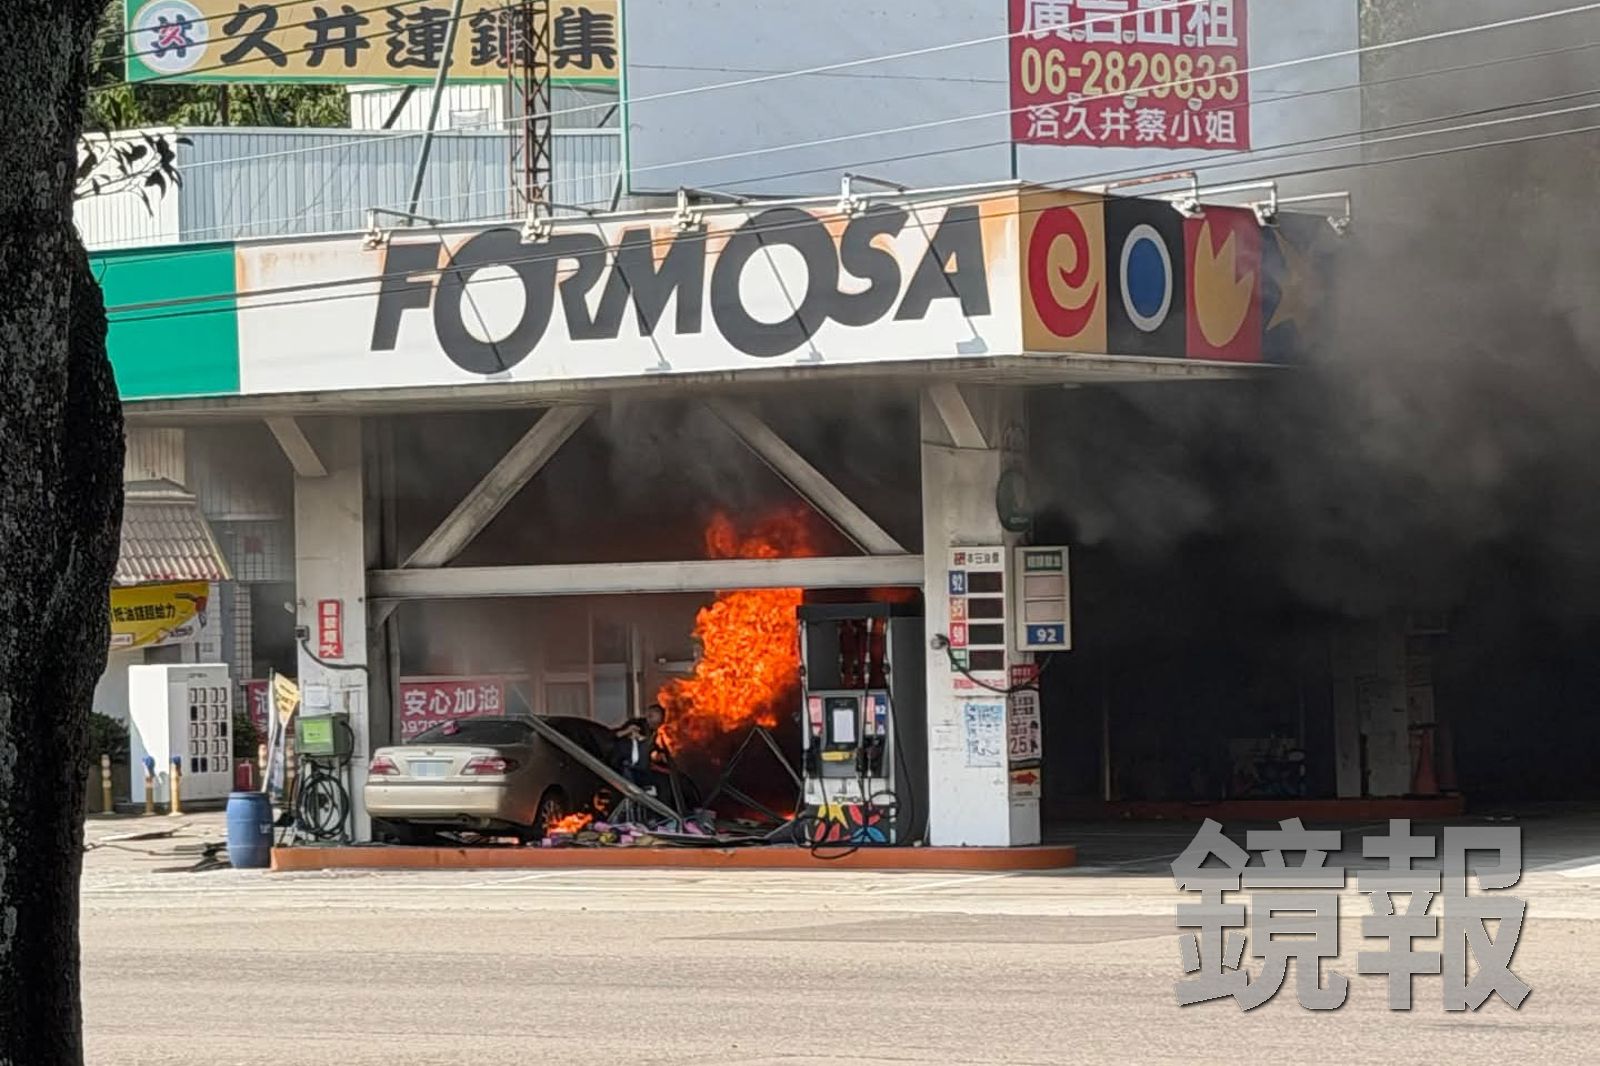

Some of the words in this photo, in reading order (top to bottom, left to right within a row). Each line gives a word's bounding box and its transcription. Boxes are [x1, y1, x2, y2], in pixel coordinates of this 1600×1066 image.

[1021, 0, 1238, 47] 廣告出租
[1020, 47, 1239, 100] 06-2829833
[1026, 105, 1237, 144] 洽久井蔡小姐
[370, 202, 992, 376] FORMOSA
[1036, 628, 1057, 642] 92
[404, 685, 499, 716] 安心加油
